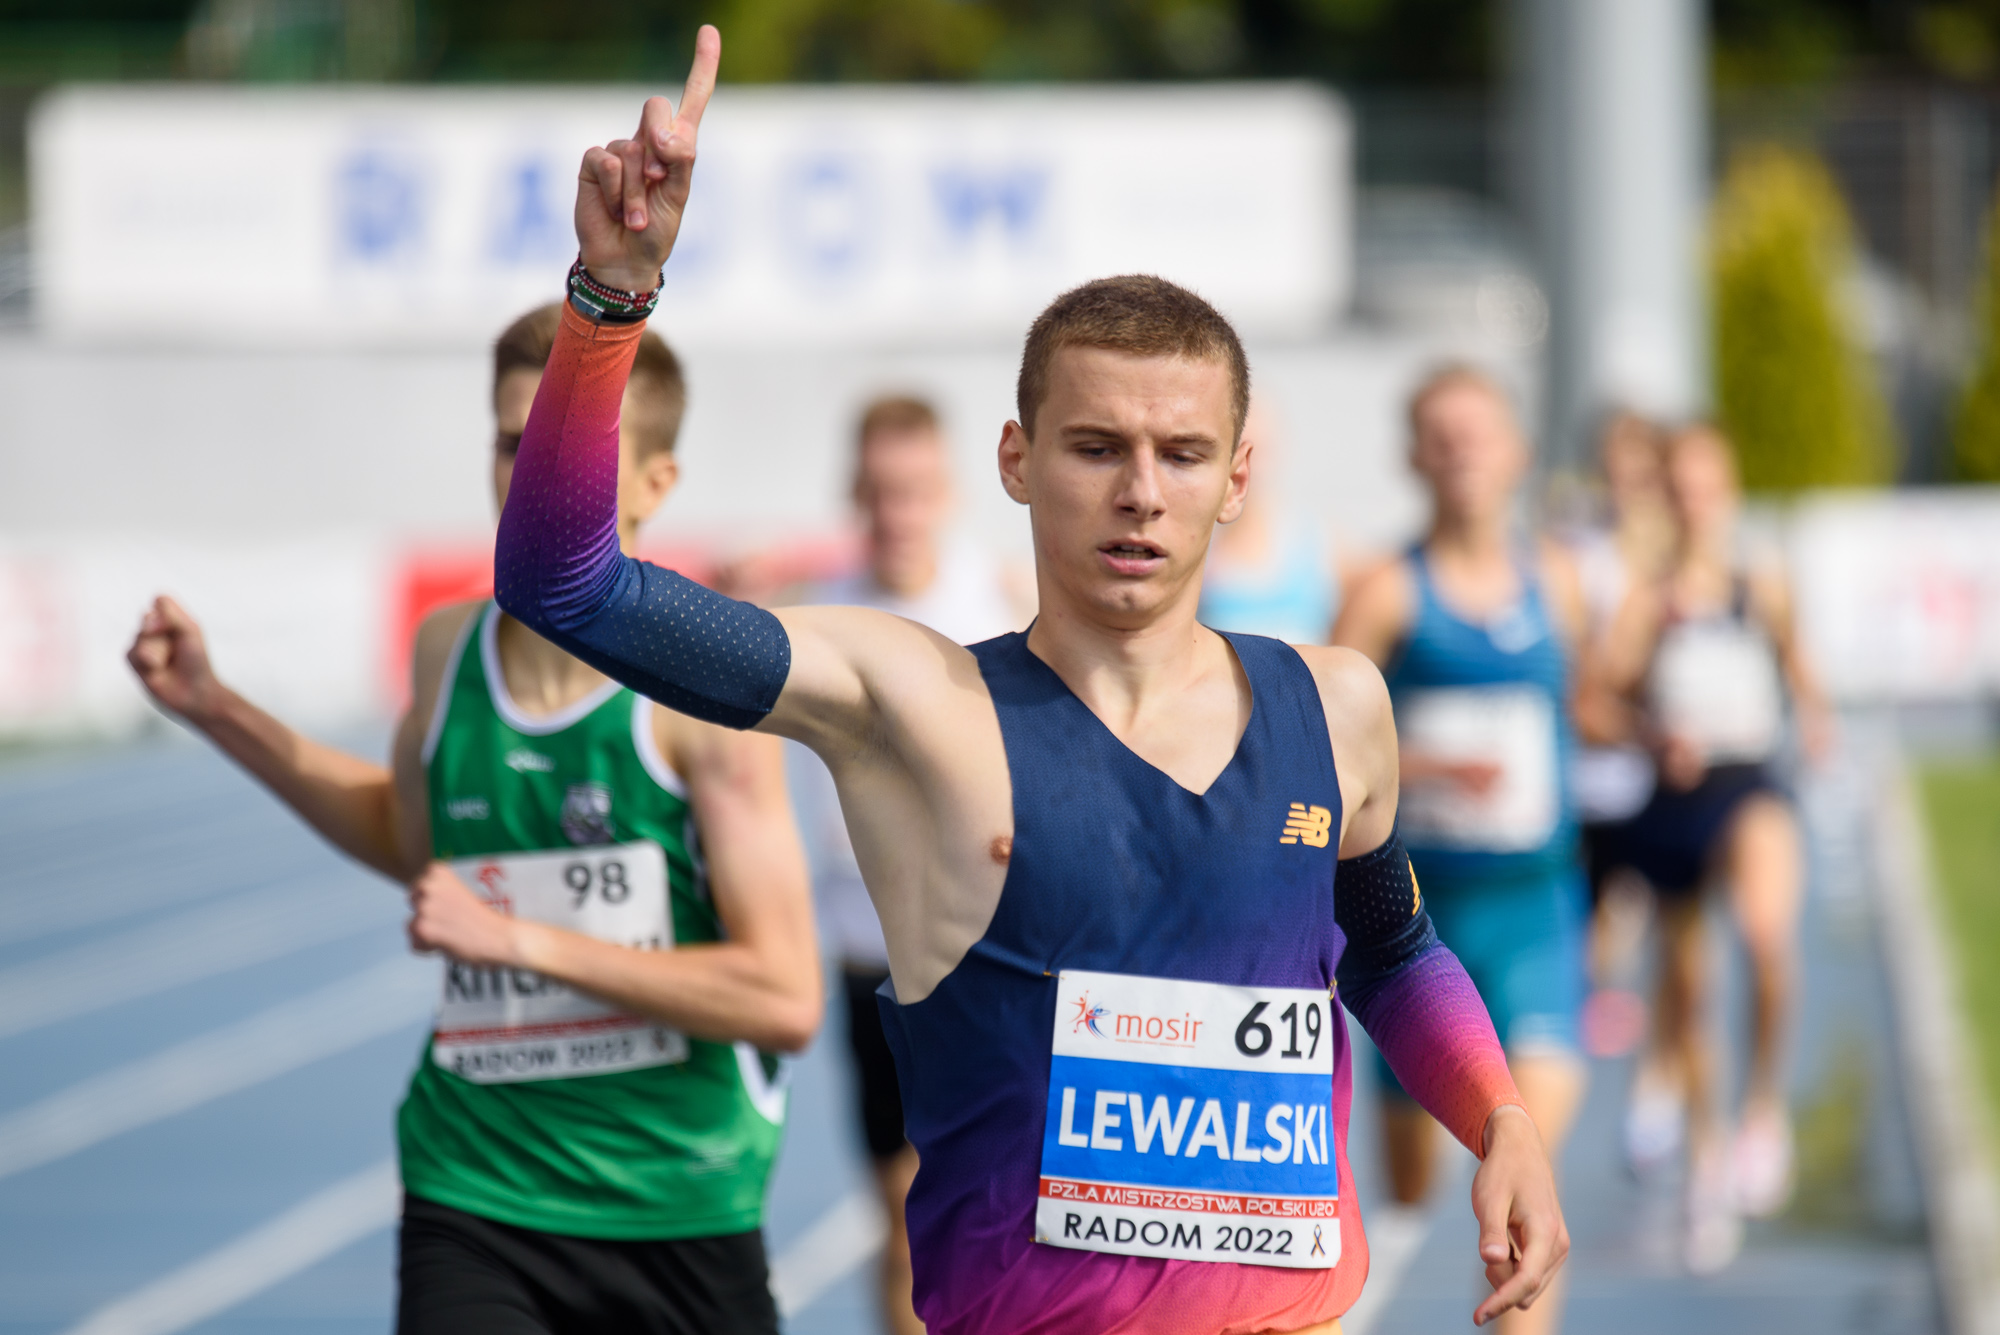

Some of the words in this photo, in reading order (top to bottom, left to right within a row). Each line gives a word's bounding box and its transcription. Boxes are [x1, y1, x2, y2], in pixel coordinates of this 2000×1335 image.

[563, 861, 629, 909] 98
[1115, 1012, 1203, 1043] mosir
[1235, 1001, 1321, 1060] 619
[1058, 1087, 1328, 1165] LEWALSKI
[1049, 1182, 1099, 1201] PZLA
[1104, 1188, 1242, 1213] MISTRZOSTWA
[1246, 1199, 1306, 1216] POLSKI
[1309, 1203, 1334, 1216] U20
[1064, 1212, 1202, 1250] RADOM
[1214, 1226, 1293, 1256] 2022
